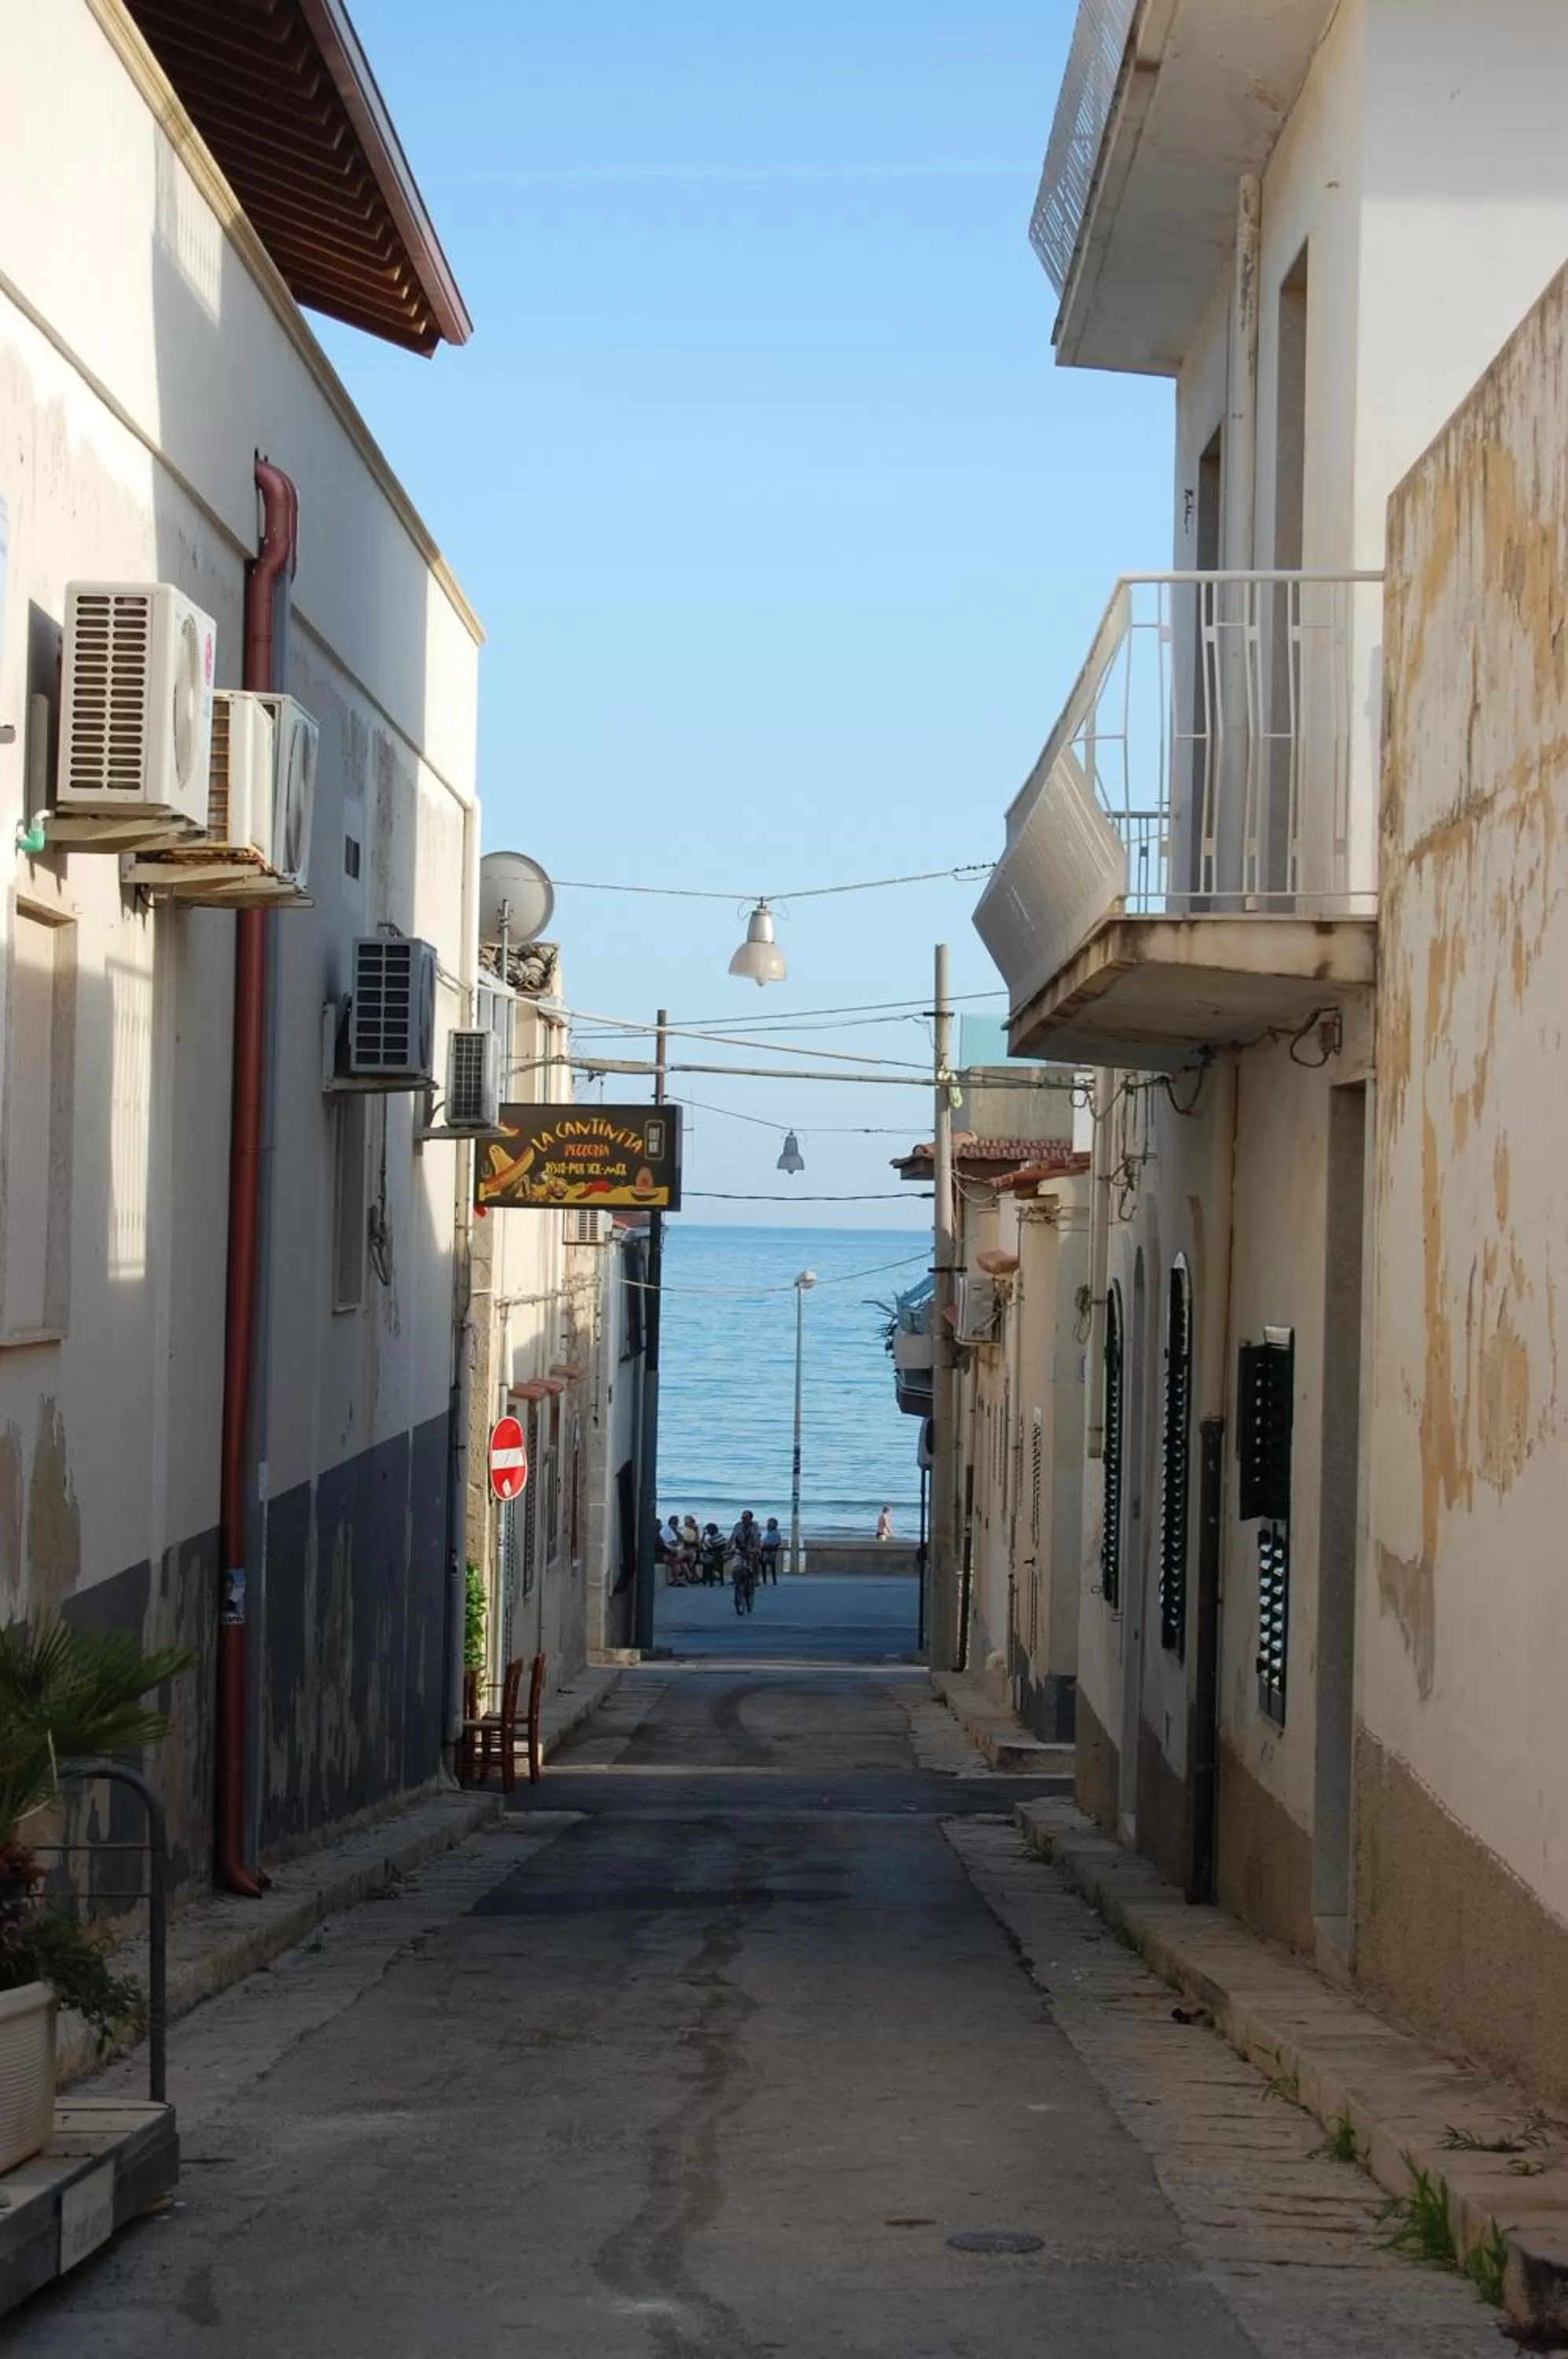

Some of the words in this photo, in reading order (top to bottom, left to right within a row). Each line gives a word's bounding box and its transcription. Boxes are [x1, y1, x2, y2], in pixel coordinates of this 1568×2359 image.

[531, 1132, 554, 1153] LA
[556, 1117, 643, 1154] CANTINITA
[565, 1143, 610, 1157] PIZZERIA
